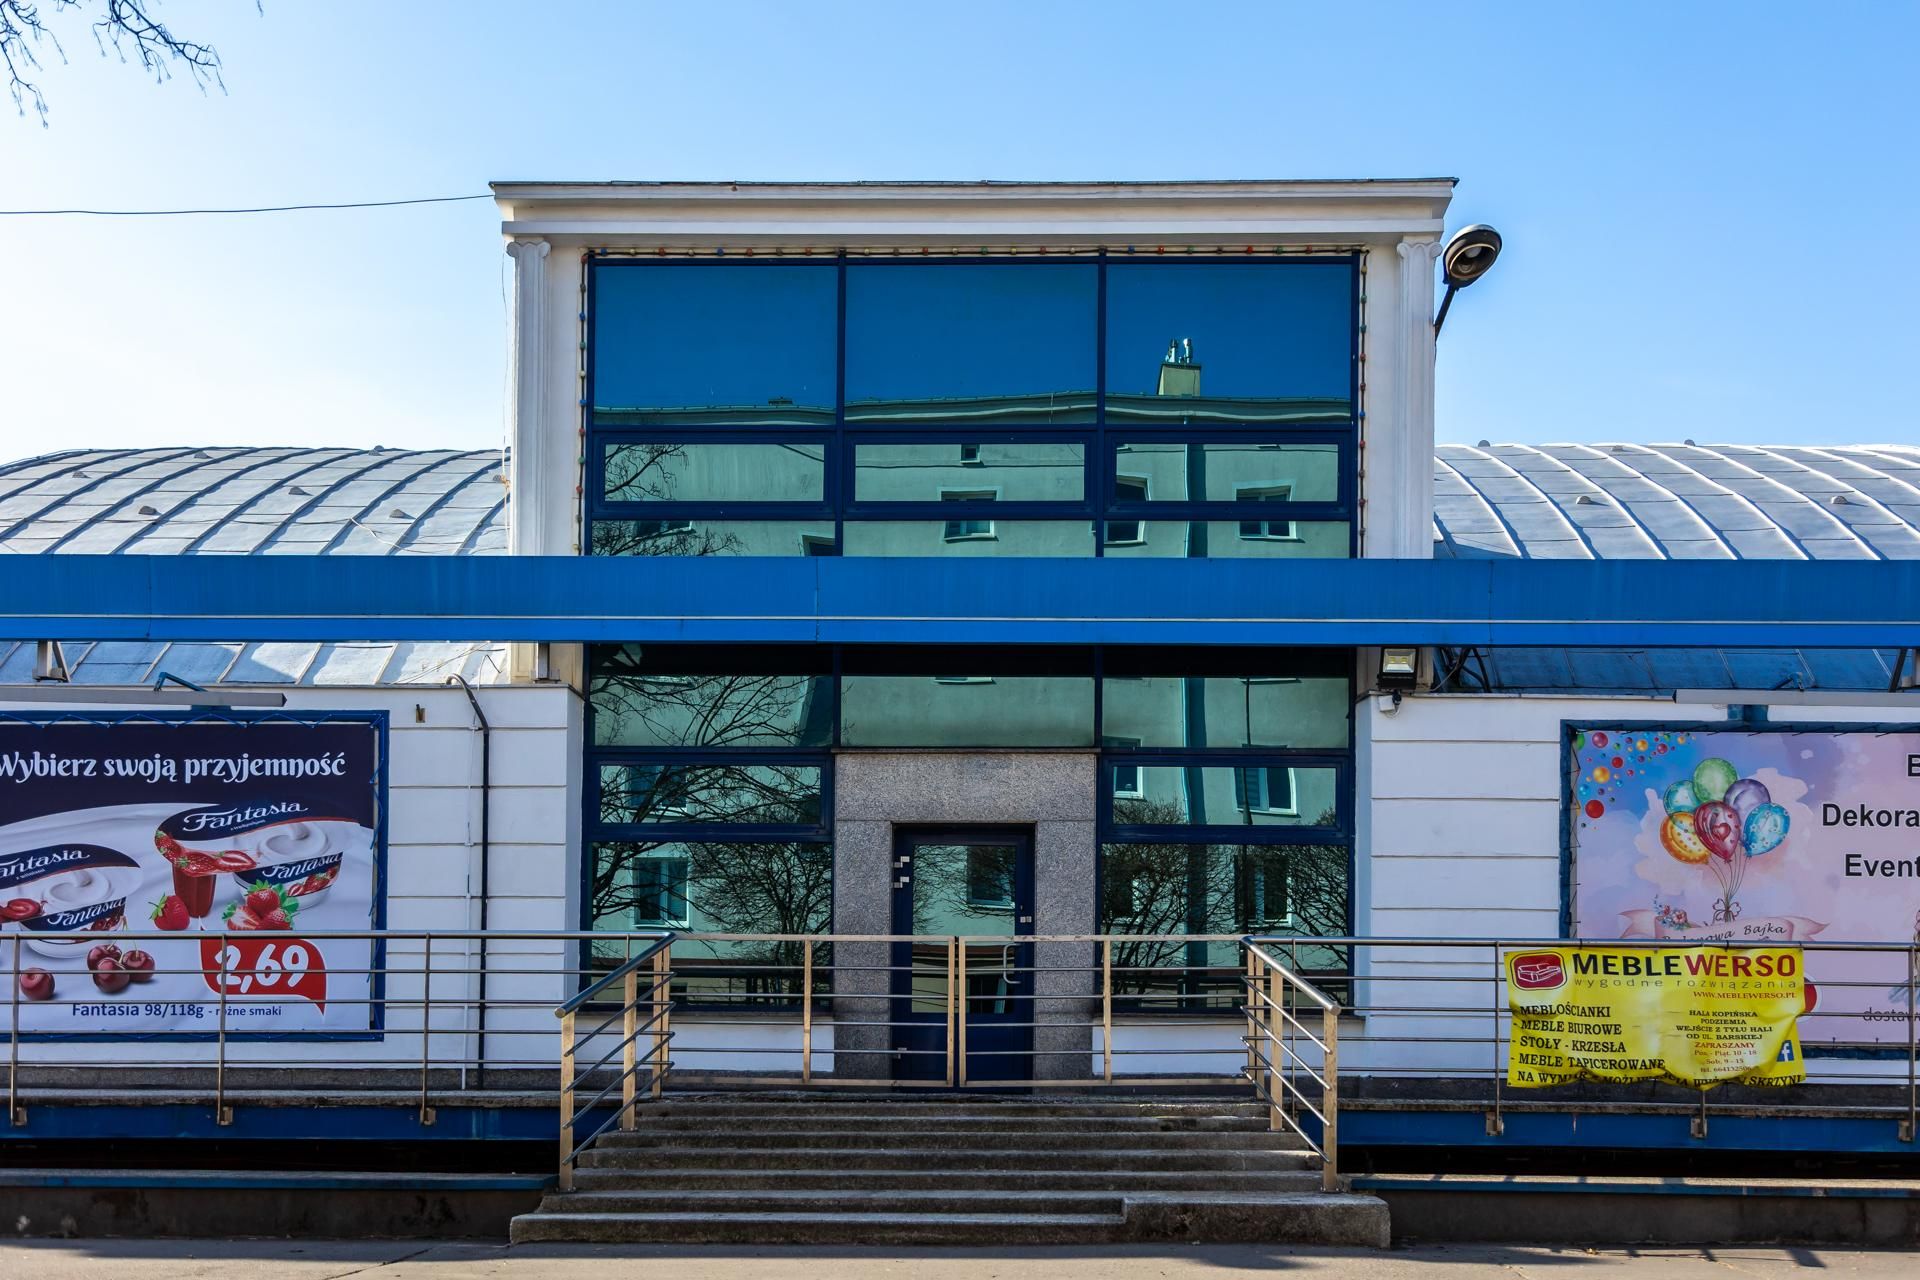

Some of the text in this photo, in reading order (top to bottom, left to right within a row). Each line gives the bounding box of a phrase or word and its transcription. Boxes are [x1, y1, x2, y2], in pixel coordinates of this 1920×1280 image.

[0, 751, 347, 784] Wybierz swoją przyjemność
[182, 802, 309, 832] Fantasia
[1822, 803, 1920, 828] Dekora
[1744, 922, 1787, 936] Bajka
[214, 943, 309, 994] 2,69
[1574, 978, 1796, 990] wygodne rozwiązania
[72, 1003, 139, 1017] Fantasia
[144, 1002, 204, 1019] 98/118g
[215, 1006, 246, 1016] rżne
[249, 1006, 282, 1016] smaki
[1521, 1020, 1564, 1033] MEBLE
[1568, 1022, 1622, 1036] BIUROWE
[1520, 1036, 1561, 1050] STOŁY
[1572, 1040, 1627, 1053] KRZESŁA
[1519, 1053, 1563, 1067] MEBLE
[1567, 1057, 1666, 1070] TAPICEROWANE
[1517, 1071, 1534, 1082] NA
